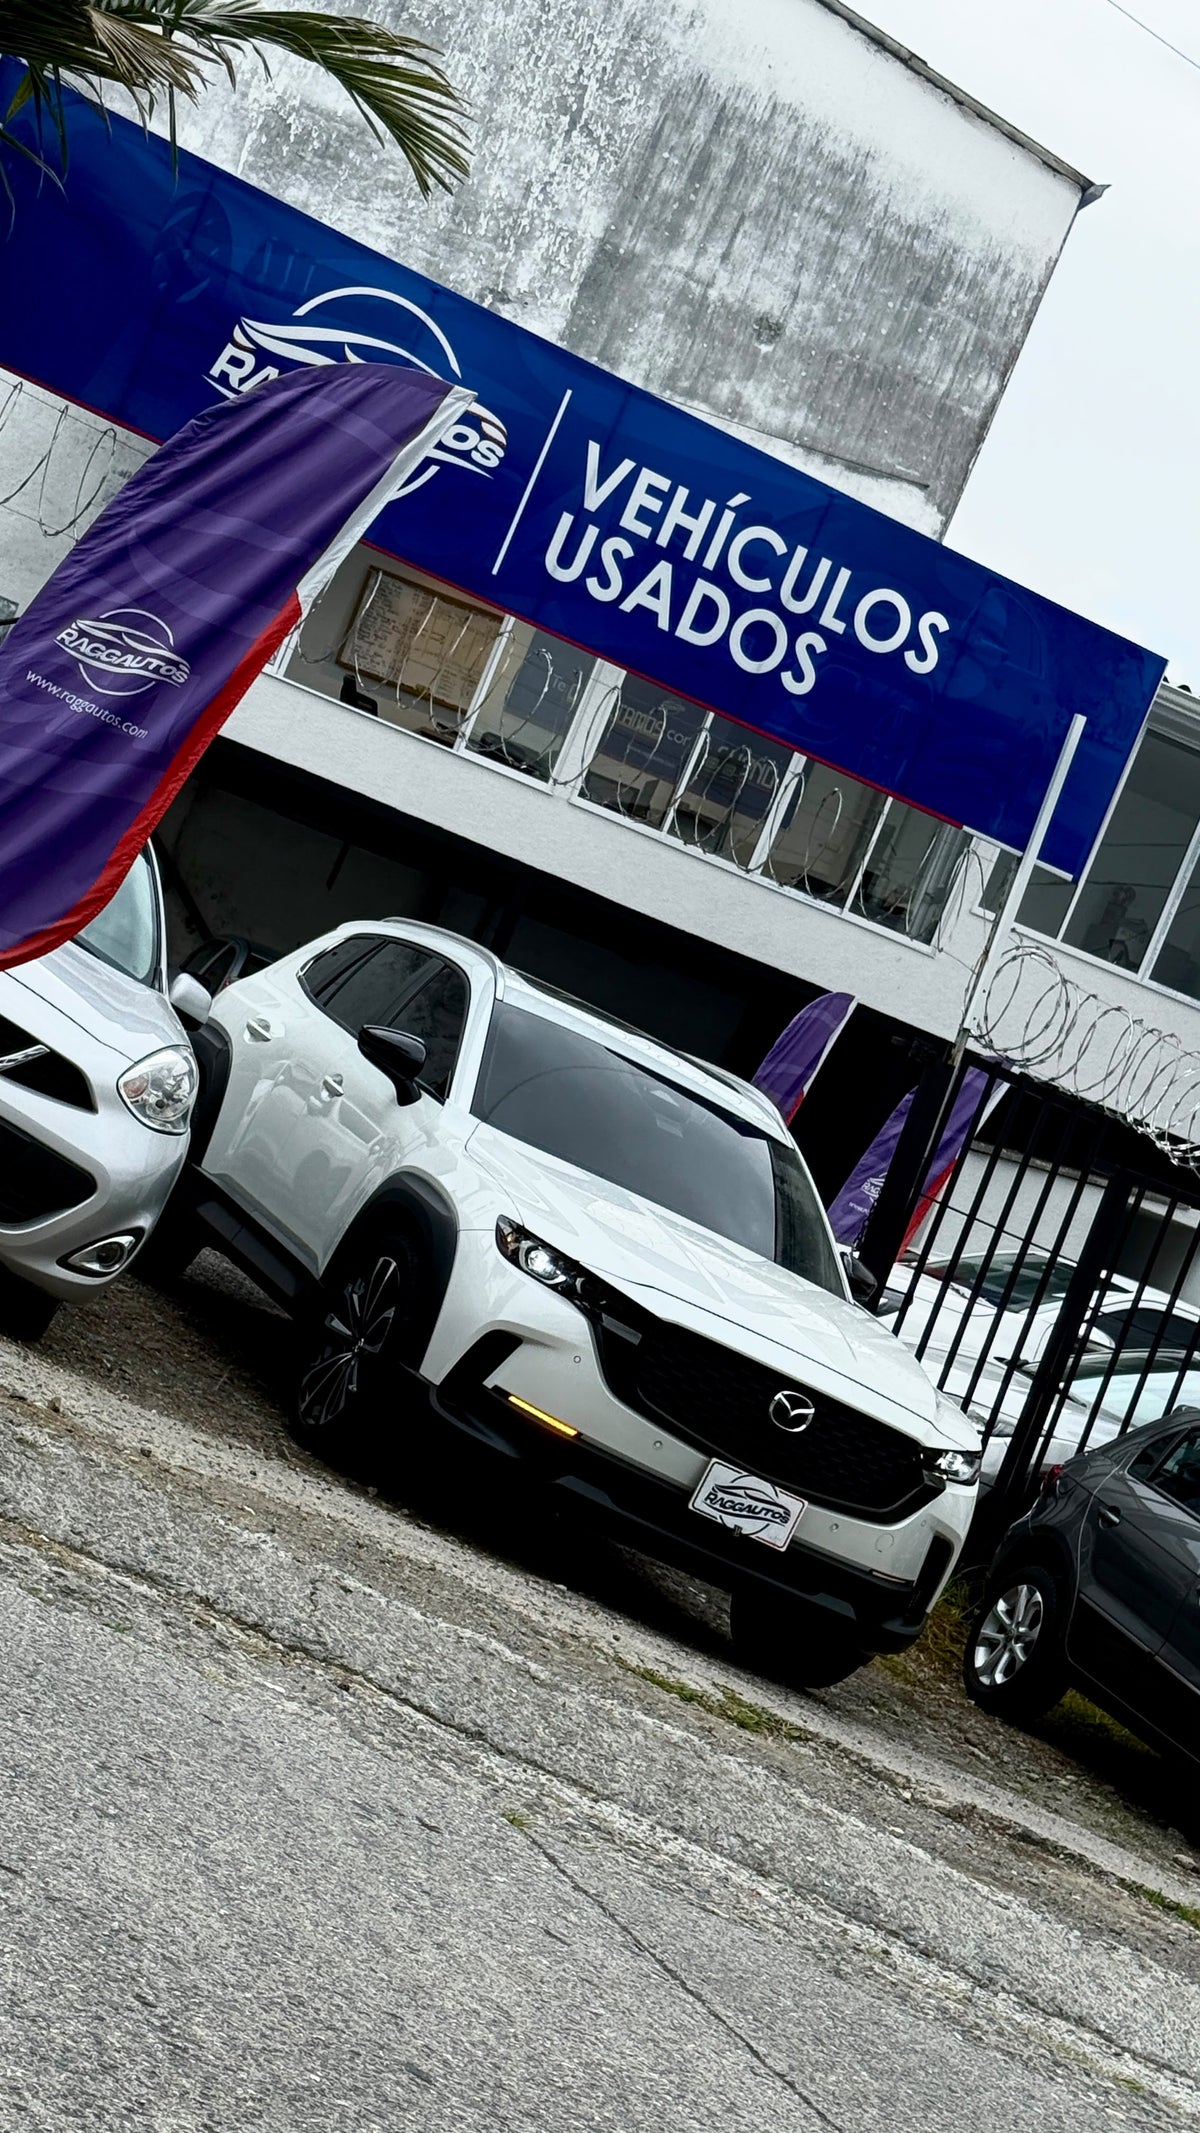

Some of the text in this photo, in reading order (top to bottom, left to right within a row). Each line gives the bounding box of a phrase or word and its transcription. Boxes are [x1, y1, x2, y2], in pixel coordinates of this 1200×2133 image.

[584, 440, 950, 675] VEHÍCULOS
[545, 511, 828, 695] USADOS
[56, 627, 189, 684] RAGGAUTOS
[26, 670, 149, 739] www.raggautos.com
[704, 1491, 790, 1525] RAGGAUTOS
